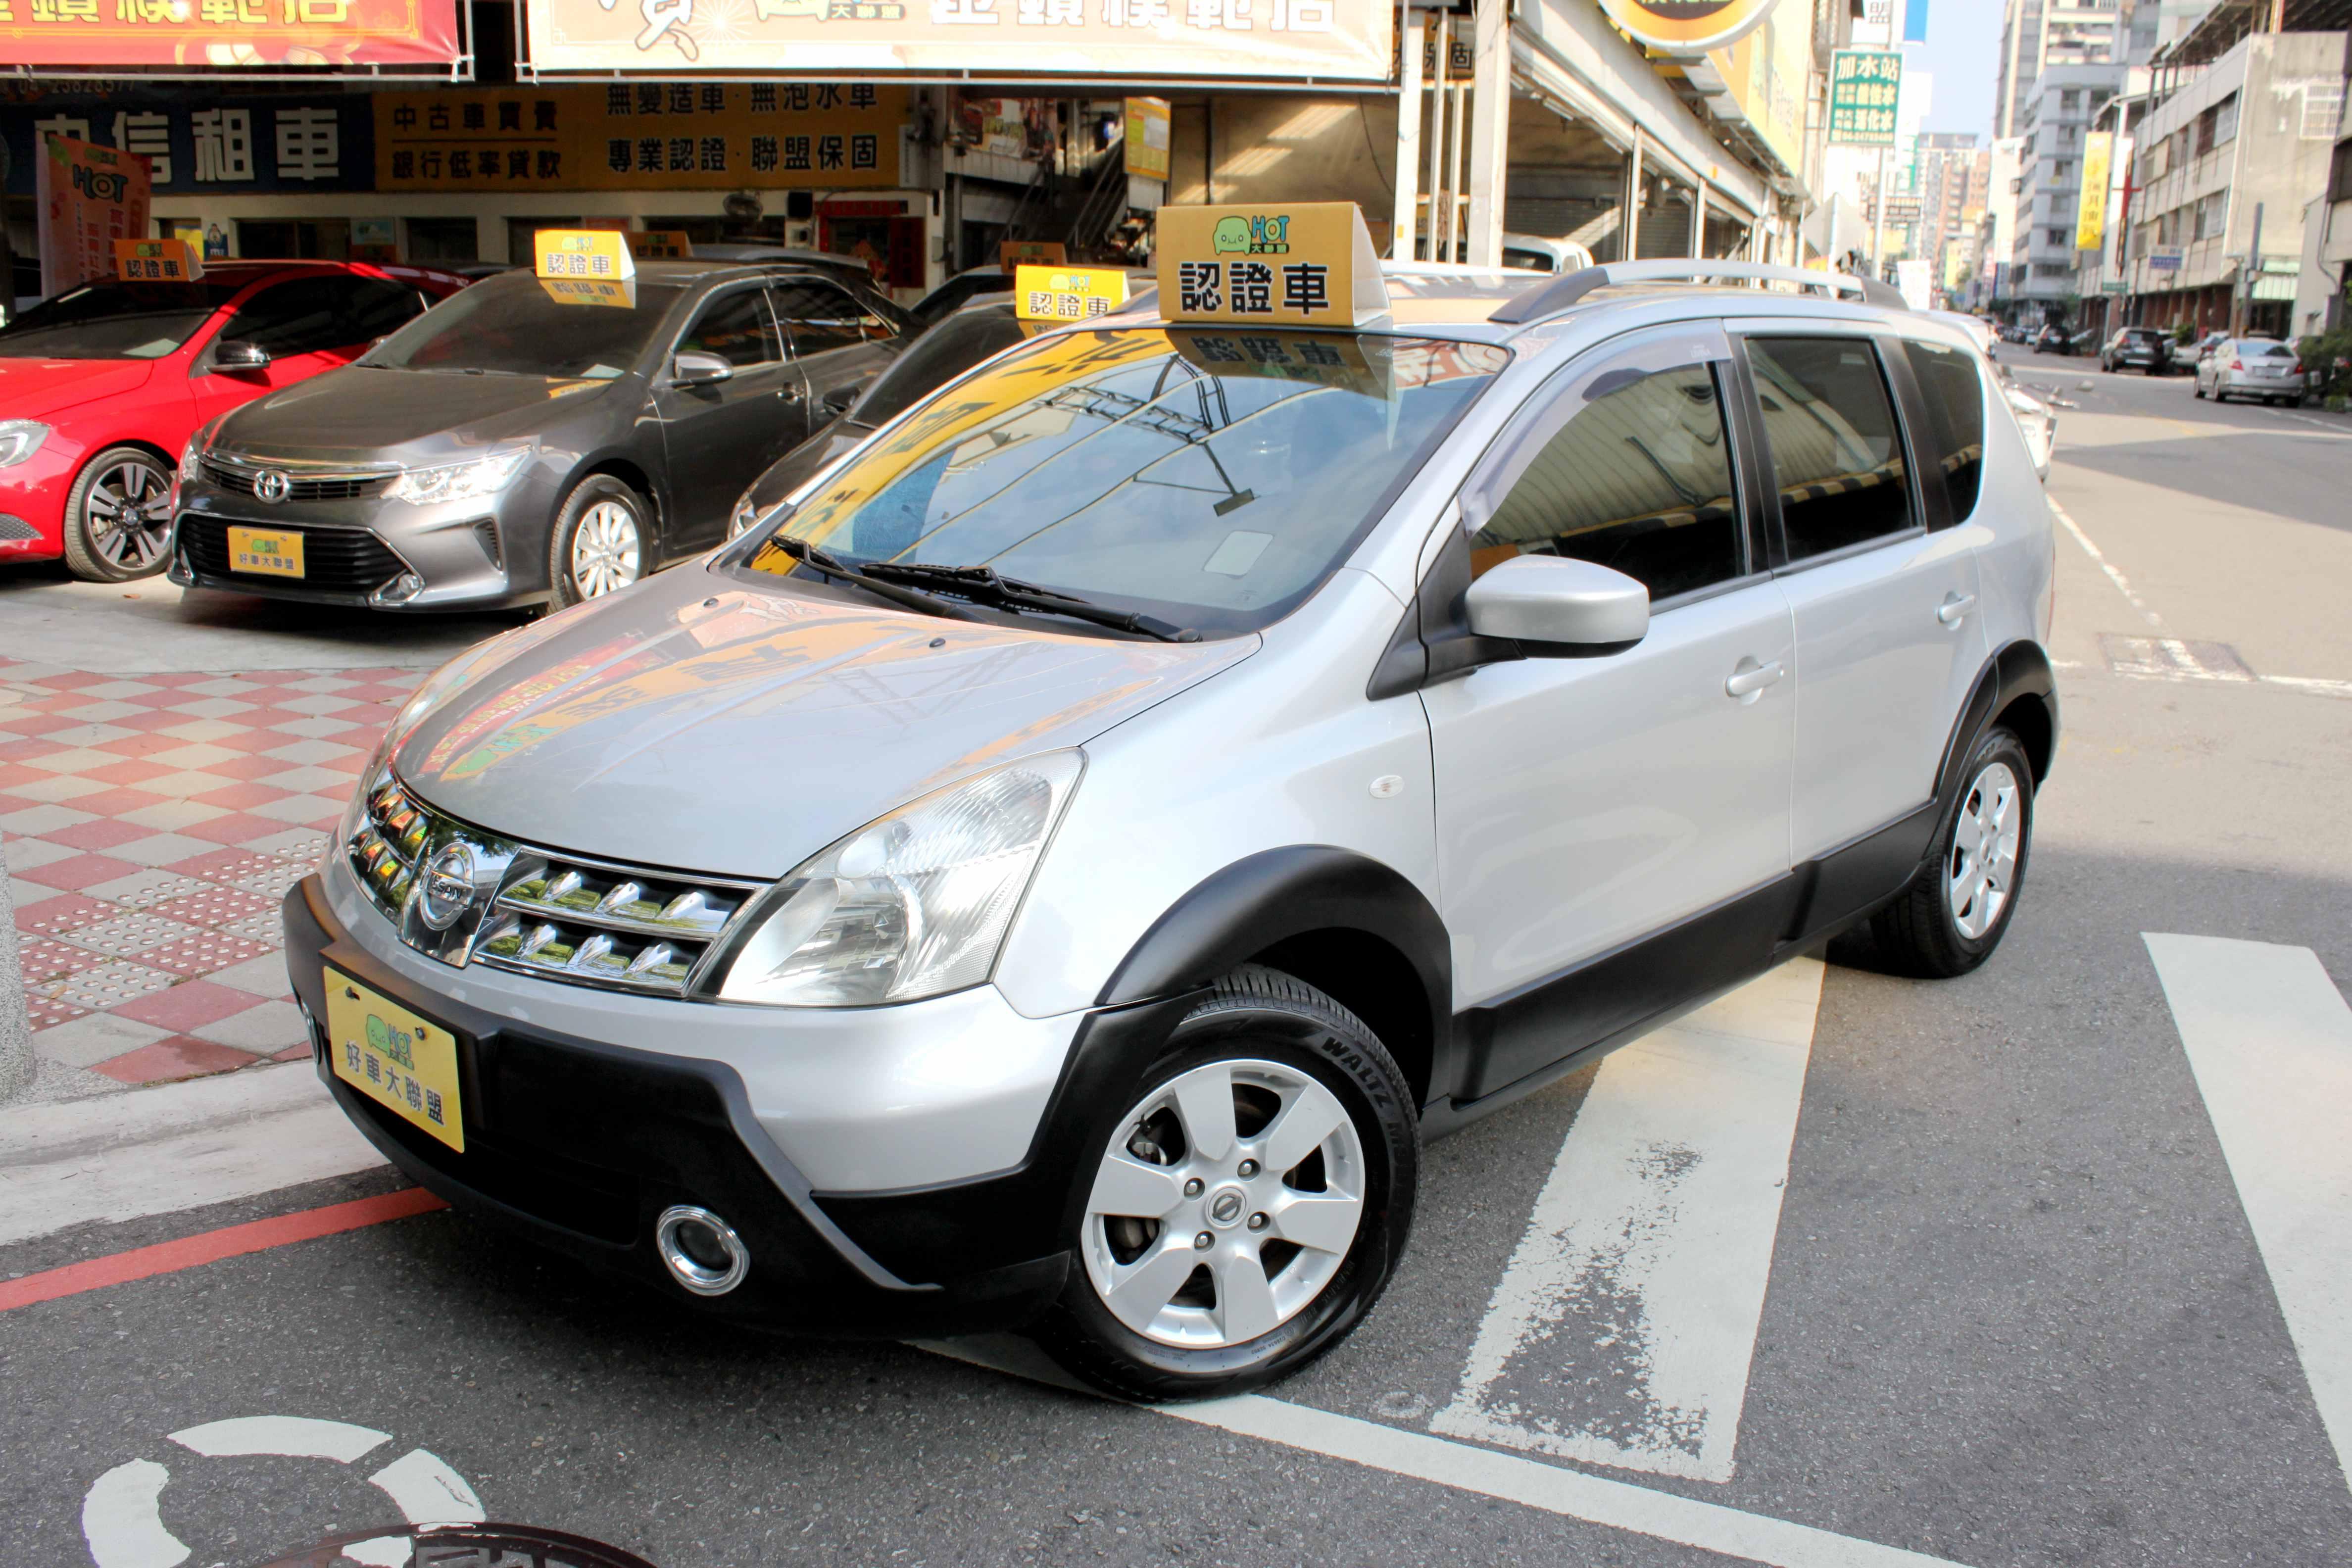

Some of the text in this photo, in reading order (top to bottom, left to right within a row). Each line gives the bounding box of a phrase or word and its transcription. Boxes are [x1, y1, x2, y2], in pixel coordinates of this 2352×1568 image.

[1837, 55, 1899, 82] 加水站
[393, 101, 557, 131] 中古車買賣
[73, 164, 128, 203] HOT
[1251, 215, 1290, 243] HOT
[126, 259, 181, 278] 認證車
[547, 253, 610, 275] 認證車
[1180, 262, 1328, 315] 認證車
[1029, 292, 1109, 317] 認證車
[240, 553, 294, 570] 好車大聯盟
[388, 1023, 412, 1058] HOT
[346, 1041, 444, 1125] 好車大聯盟
[1322, 1037, 1394, 1108] WALTZ
